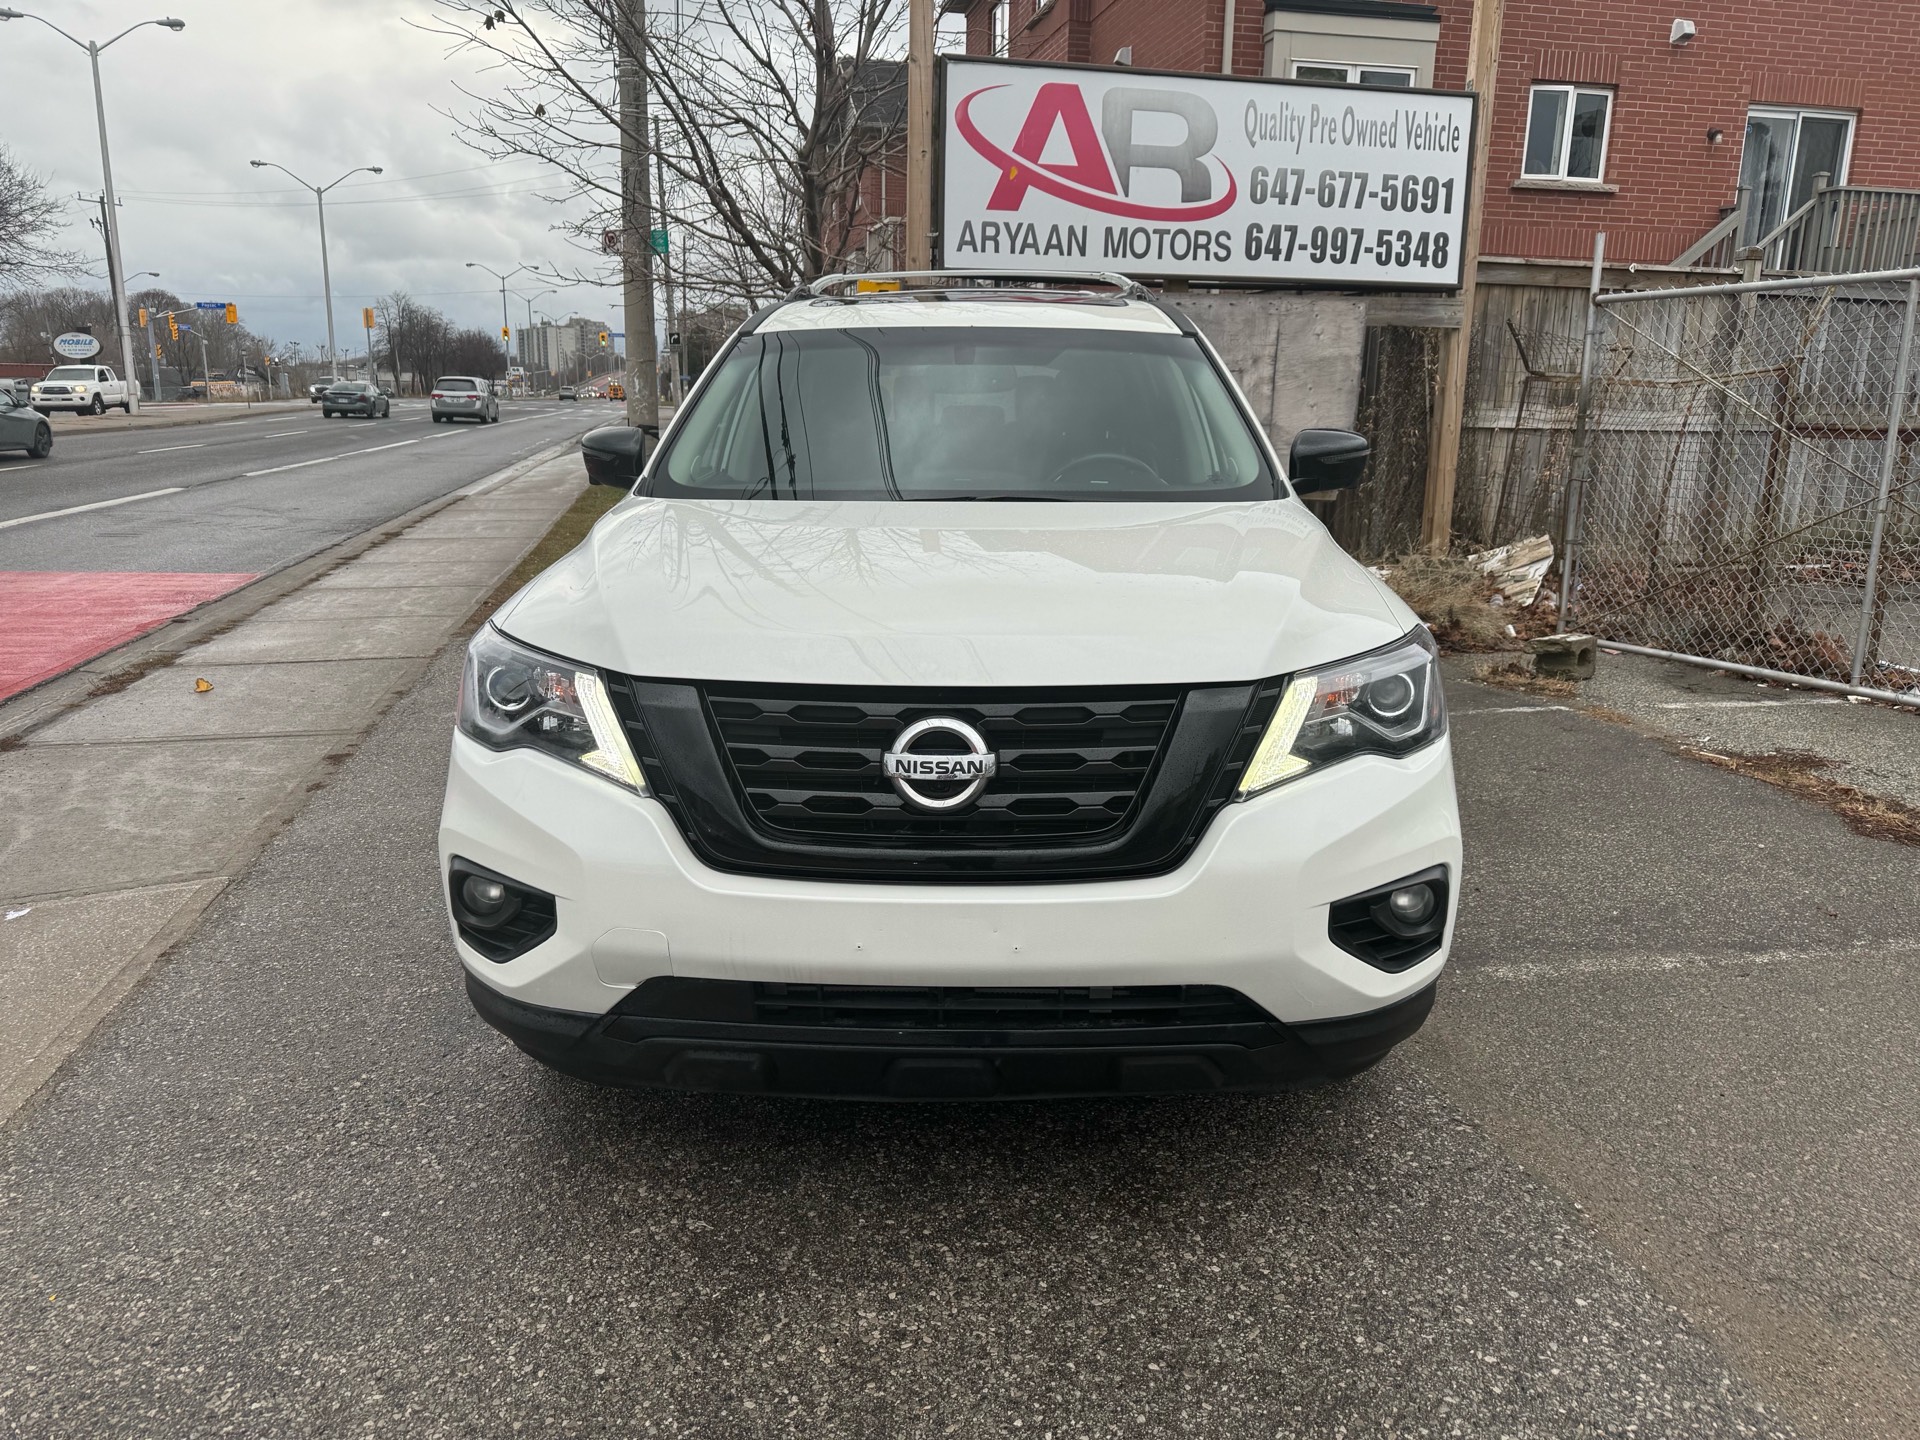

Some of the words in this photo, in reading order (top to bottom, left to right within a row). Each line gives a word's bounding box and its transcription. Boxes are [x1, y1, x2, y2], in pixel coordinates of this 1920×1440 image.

[1244, 98, 1306, 155] Quality
[1309, 103, 1337, 145] Pre
[1341, 105, 1399, 149] Owned
[1405, 110, 1460, 153] Vehicle
[1249, 165, 1455, 214] 647-677-5691
[956, 219, 1088, 257] ARYAAN
[1103, 226, 1232, 262] MOTORS
[1244, 222, 1450, 269] 647-997-5348
[59, 338, 94, 346] MOBILE
[895, 759, 984, 775] NISSAN
